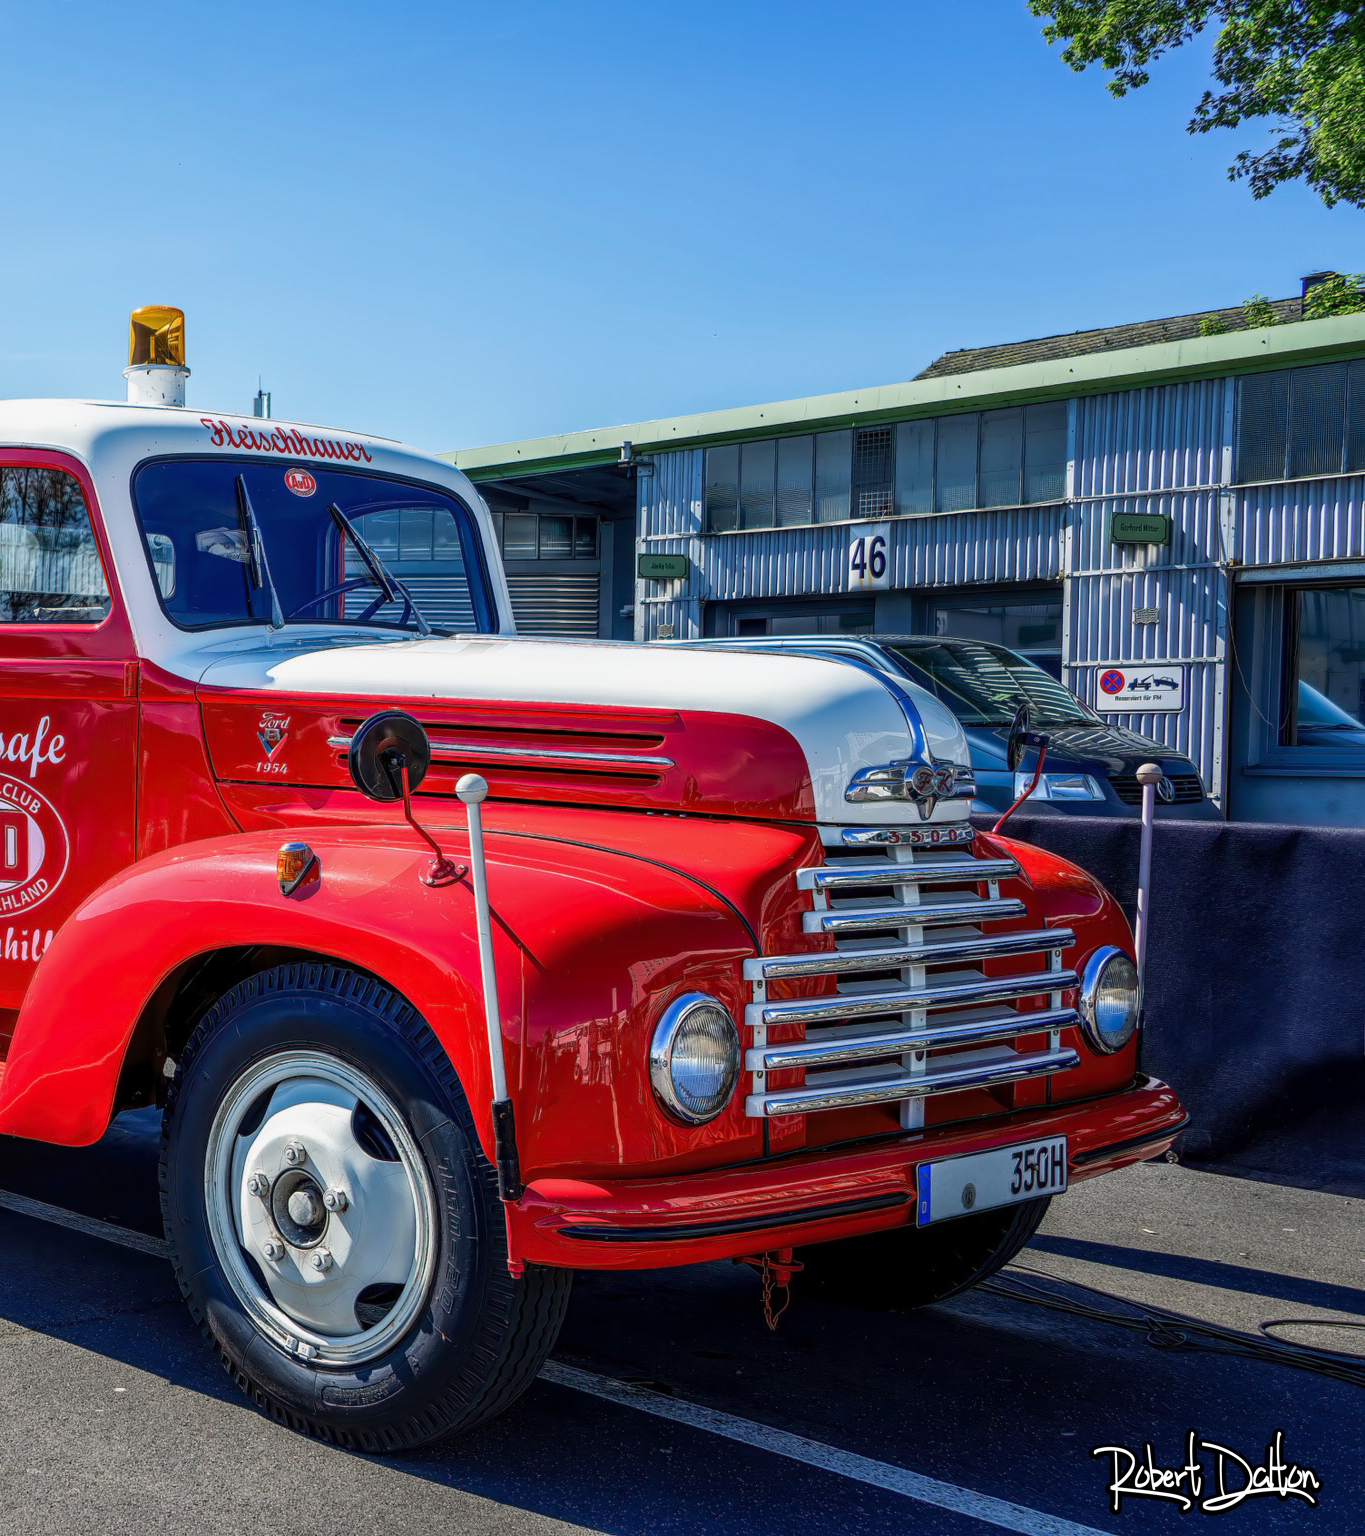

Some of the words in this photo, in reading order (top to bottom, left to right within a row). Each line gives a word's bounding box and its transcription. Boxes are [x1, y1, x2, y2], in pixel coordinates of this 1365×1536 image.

[200, 418, 373, 464] Fleischhauer
[291, 475, 311, 490] AvD
[851, 535, 887, 579] 46
[259, 711, 291, 729] Ford
[256, 761, 289, 774] 1954
[888, 829, 958, 844] 3500
[1010, 1143, 1064, 1195] 350H
